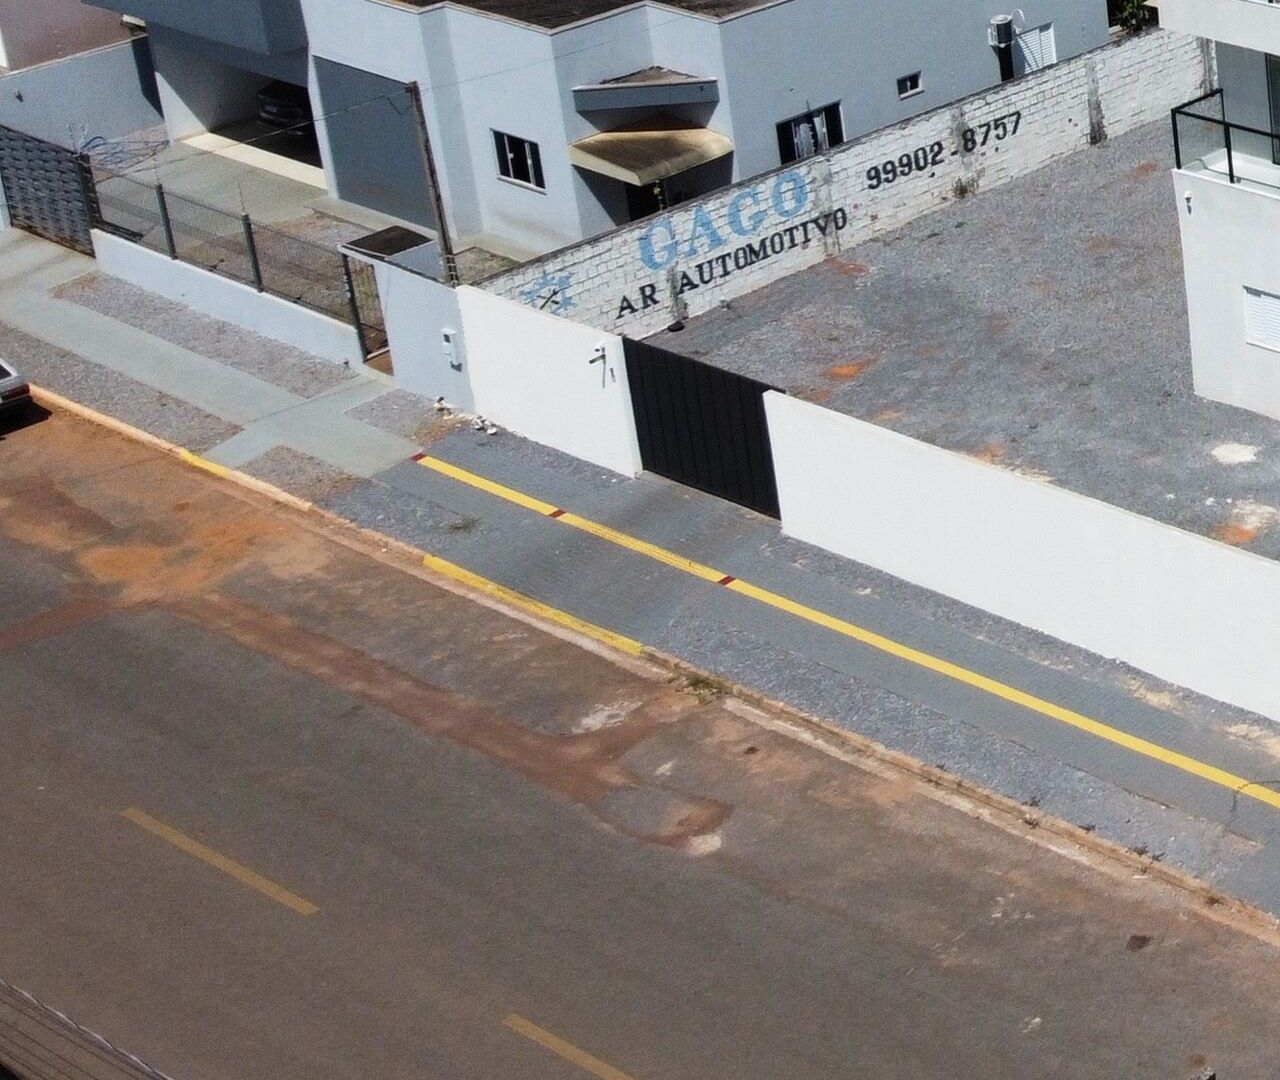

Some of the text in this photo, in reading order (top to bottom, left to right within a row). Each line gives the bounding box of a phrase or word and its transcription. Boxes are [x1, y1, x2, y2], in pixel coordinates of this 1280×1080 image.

[615, 207, 848, 320] AR AUTOMOTIVO
[638, 172, 809, 271] GAGO
